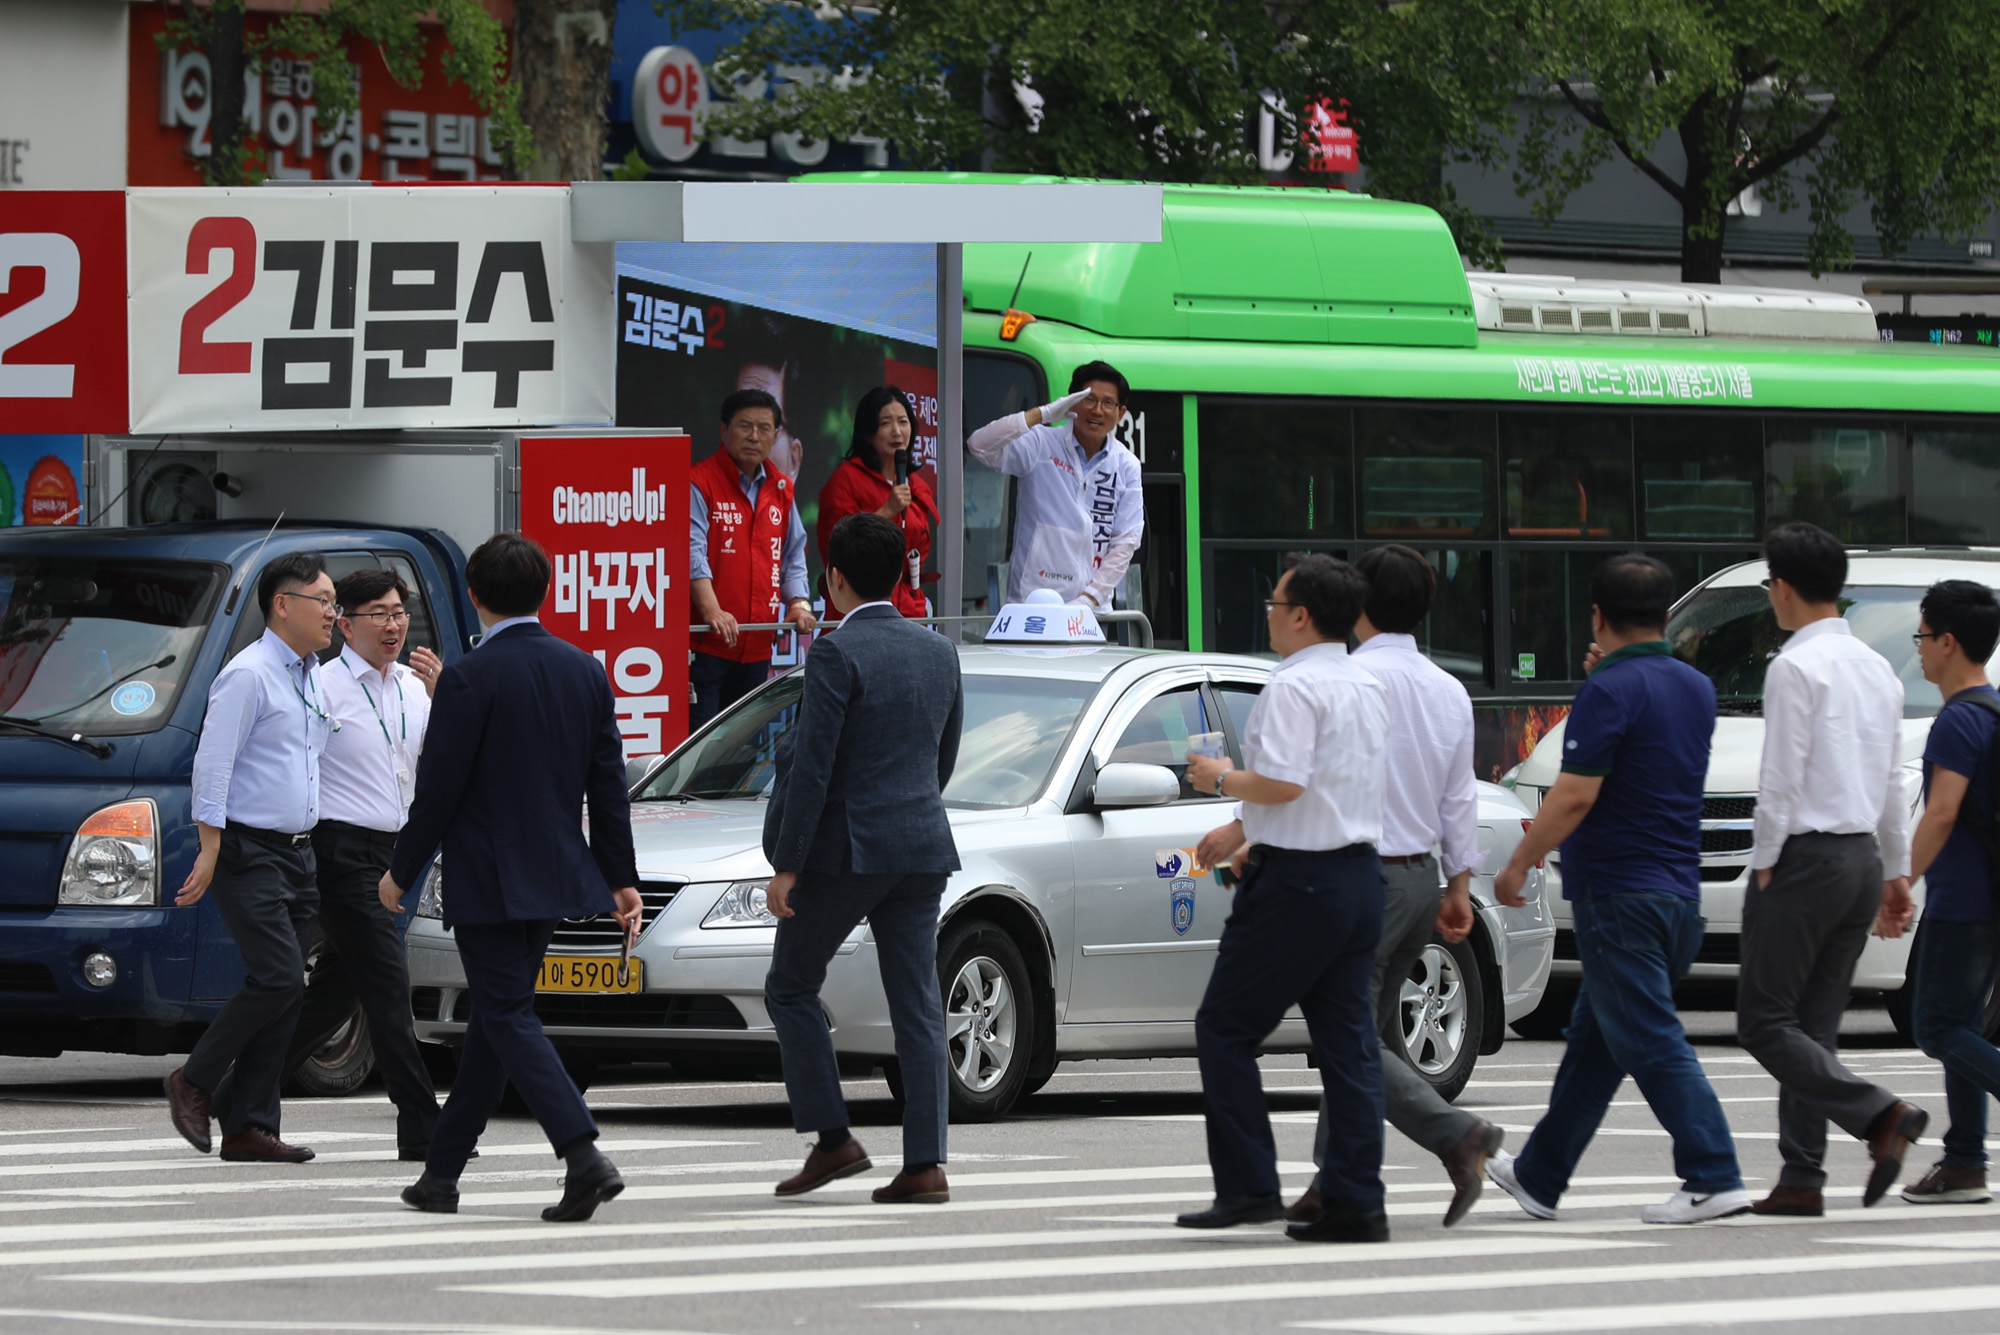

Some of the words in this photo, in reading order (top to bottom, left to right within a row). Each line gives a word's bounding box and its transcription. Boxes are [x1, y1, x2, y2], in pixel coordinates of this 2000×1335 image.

[657, 62, 698, 146] 약
[0, 232, 81, 398] 2
[178, 216, 257, 375] 2
[261, 239, 555, 410] 김문수
[624, 292, 705, 356] 김문수
[706, 305, 726, 348] 2
[1513, 358, 1555, 393] 시민과
[1552, 359, 1584, 394] 함께
[1580, 361, 1624, 395] 만드는
[1622, 364, 1664, 399] 최고의
[1661, 364, 1727, 399] 재활용도시
[1724, 365, 1753, 399] 서울
[1113, 410, 1146, 464] 31
[712, 511, 743, 525] 구청장
[1089, 470, 1118, 552] 김문수
[553, 548, 670, 632] 바꾸자
[593, 645, 670, 761] 울
[1520, 660, 1534, 672] CNG
